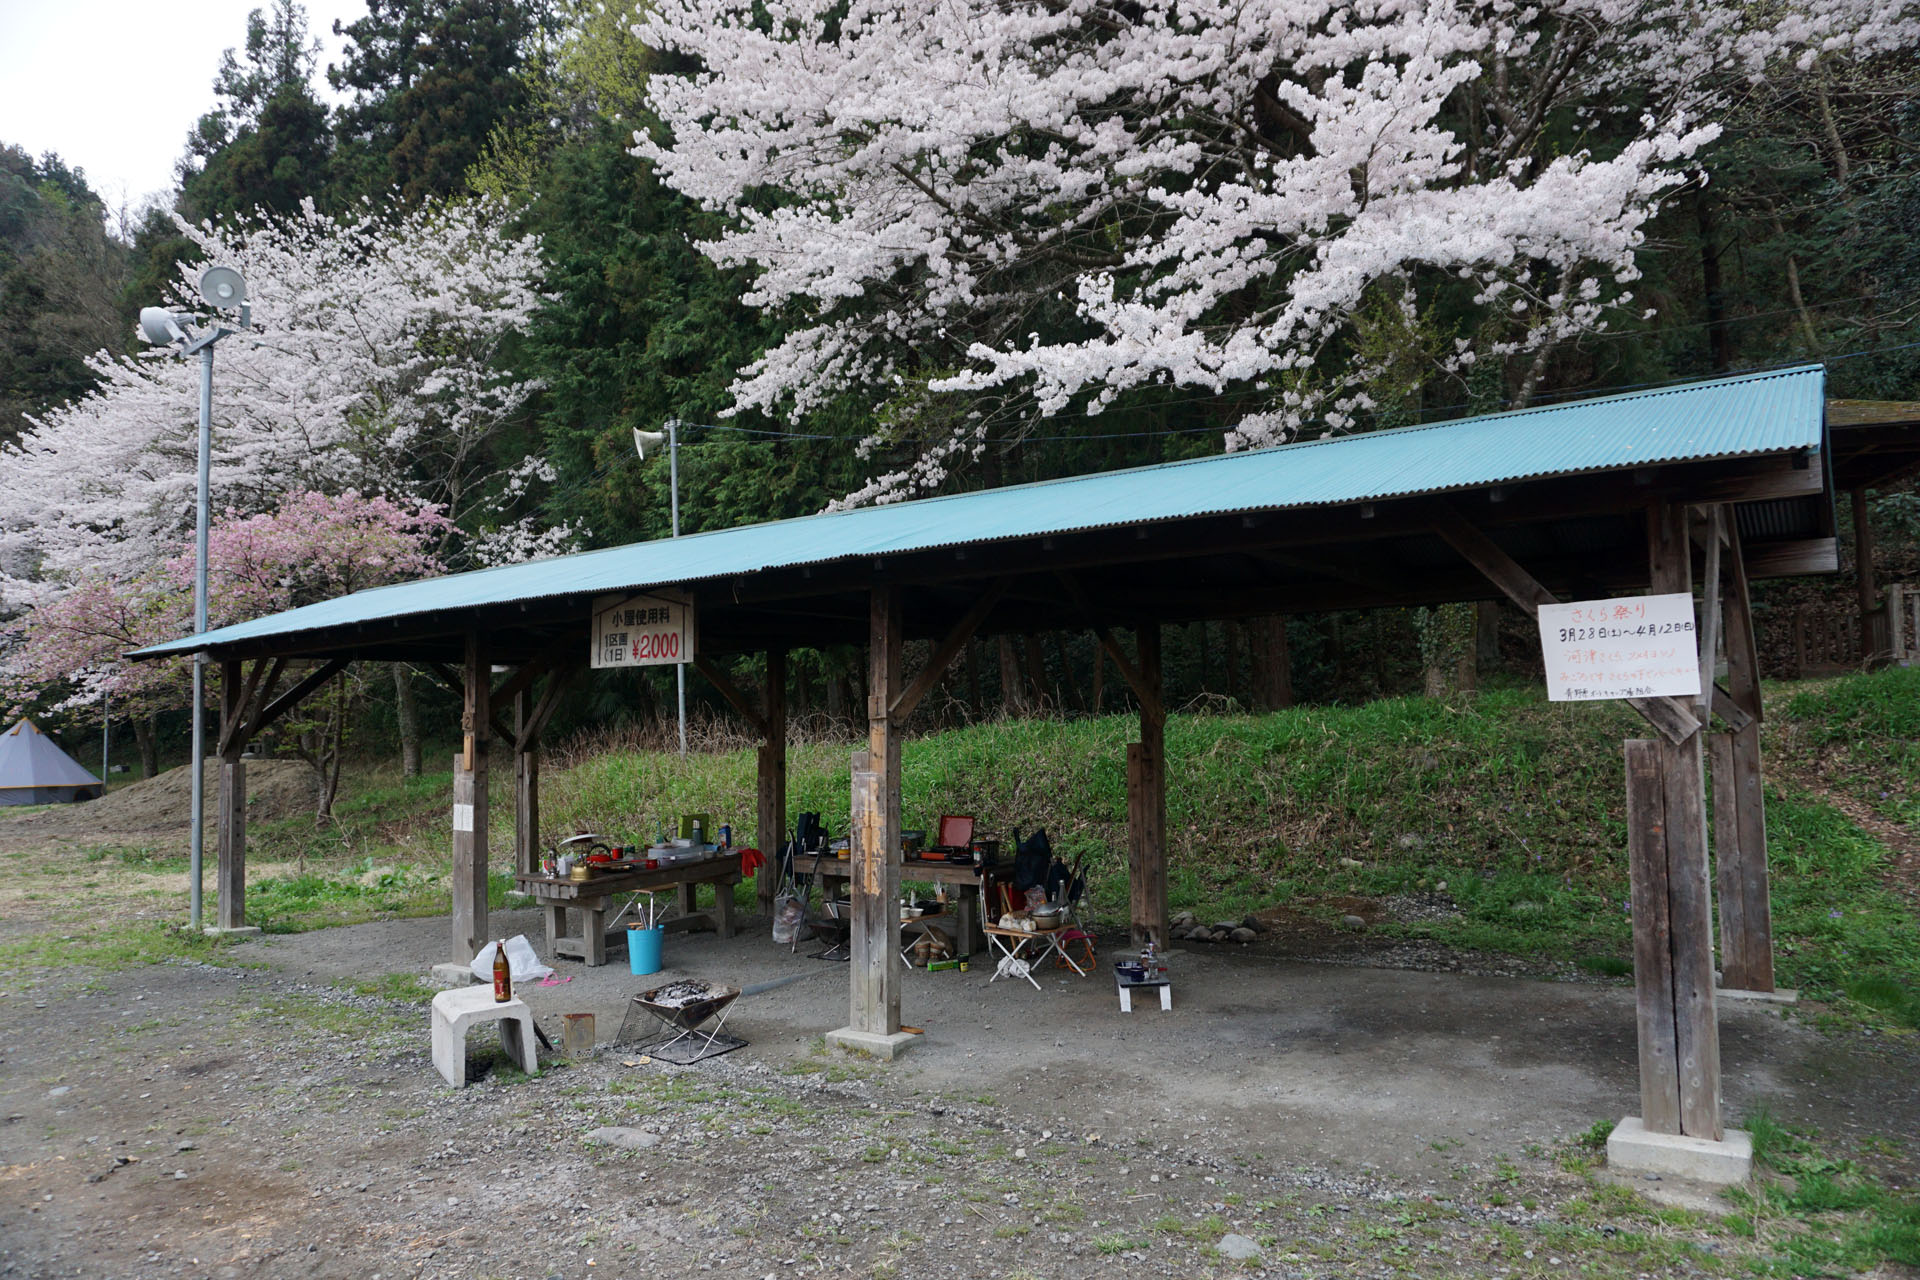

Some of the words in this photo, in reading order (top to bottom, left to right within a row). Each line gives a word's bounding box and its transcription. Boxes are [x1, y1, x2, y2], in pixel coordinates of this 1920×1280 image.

[612, 607, 670, 627] 小屋使用料
[1571, 602, 1646, 623] さくら祭り
[604, 632, 628, 648] 1区画
[632, 632, 679, 660] ¥2,000
[604, 647, 627, 662] (1日)
[464, 717, 471, 729] 2
